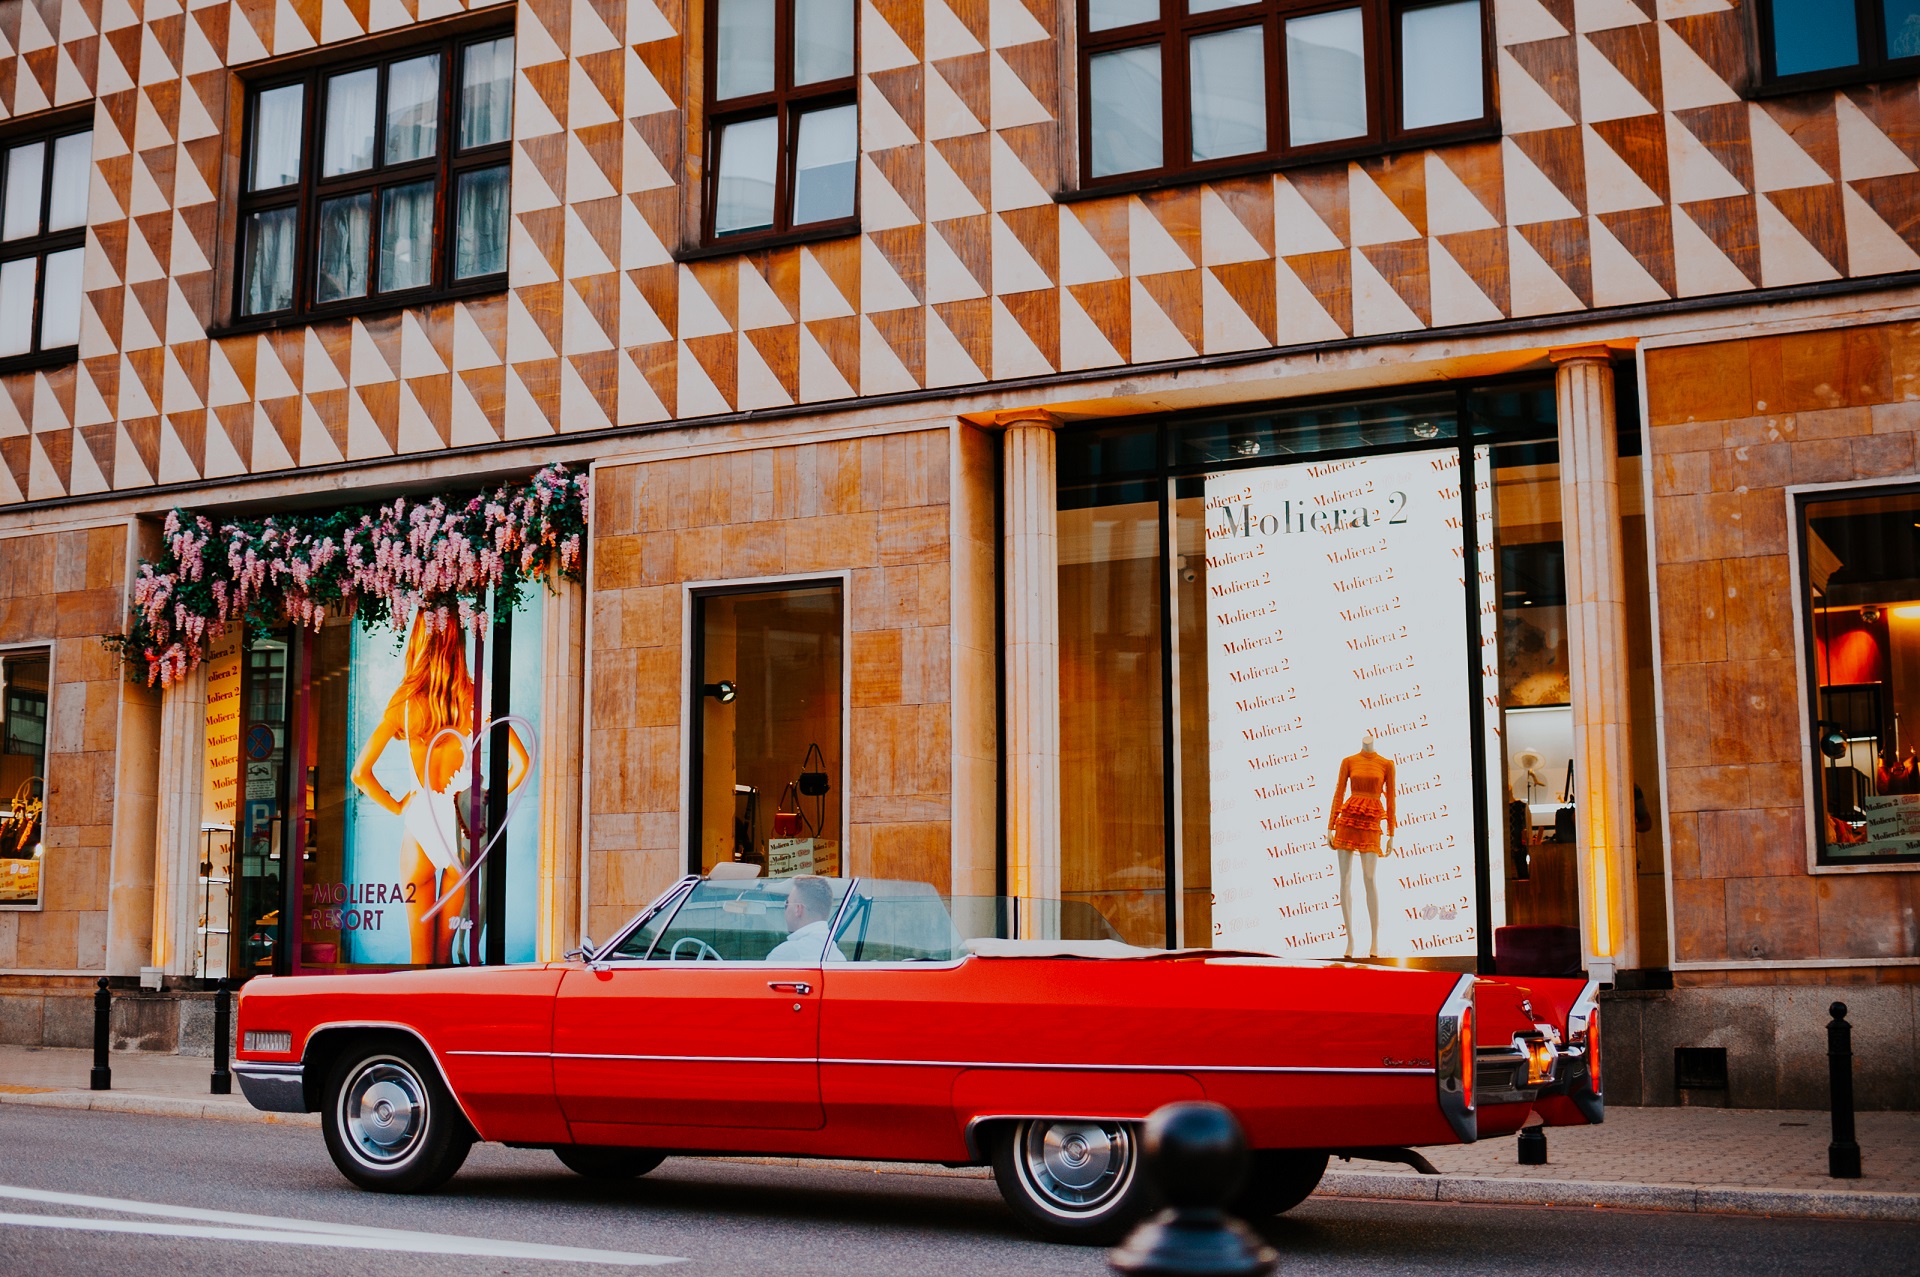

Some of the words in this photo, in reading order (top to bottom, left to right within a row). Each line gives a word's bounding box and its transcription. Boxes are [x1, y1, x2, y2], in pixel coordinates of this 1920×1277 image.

[1206, 493, 1241, 511] oliera
[1244, 487, 1252, 499] 2
[1314, 488, 1362, 508] Moliera
[1365, 480, 1374, 495] 2
[1219, 500, 1370, 540] Moliera
[1389, 491, 1408, 524] 2
[1250, 515, 1258, 527] 2
[1372, 509, 1381, 521] 2
[1205, 552, 1253, 571] Moliera
[1256, 544, 1264, 559] 2
[1327, 546, 1376, 565] Moliera
[1379, 538, 1388, 553] 2
[1211, 579, 1259, 598] Moliera
[1262, 572, 1270, 586] 2
[1333, 575, 1382, 594] Moliera
[1385, 568, 1394, 582] 2
[1217, 609, 1265, 629] Moliera
[1268, 600, 1276, 616] 2
[1340, 604, 1389, 623] Moliera
[1392, 596, 1400, 611] 2
[229, 645, 235, 654] 2
[1223, 638, 1272, 658] Moliera
[1275, 630, 1284, 645] 2
[1346, 633, 1396, 652] Moliera
[1399, 626, 1408, 640] 2
[208, 669, 231, 682] oliera
[232, 666, 238, 675] 2
[1229, 665, 1278, 684] Moliera
[1281, 658, 1290, 672] 2
[1353, 662, 1403, 682] Moliera
[1406, 654, 1414, 669] 2
[234, 687, 240, 696] 2
[1236, 695, 1285, 714] Moliera
[1288, 688, 1296, 702] 2
[1360, 692, 1410, 711] Moliera
[1413, 684, 1422, 699] 2
[206, 712, 235, 726] Moliera
[1242, 724, 1291, 742] Moliera
[1294, 716, 1302, 730] 2
[1420, 715, 1428, 727] 2
[208, 734, 238, 747] Moliera
[1248, 753, 1297, 771] Moliera
[1300, 746, 1308, 759] 2
[1394, 749, 1423, 766] liera
[1427, 745, 1435, 756] 2
[1254, 782, 1304, 801] Moliera
[1307, 774, 1316, 789] 2
[1434, 774, 1442, 787] 2
[1260, 814, 1310, 832] Moliera
[1313, 806, 1322, 820] 2
[1441, 804, 1448, 817] 2
[1267, 842, 1317, 861] Moliera
[1320, 834, 1328, 849] 2
[1393, 842, 1443, 860] Moliera
[1446, 834, 1454, 848] 2
[1273, 872, 1323, 890] Moliera
[1326, 864, 1334, 878] 2
[1398, 873, 1450, 891] Moliera
[1453, 866, 1462, 879] 2
[312, 883, 417, 904] MOLIERA2
[1460, 896, 1468, 909] 2
[311, 909, 384, 931] RESORT
[1279, 901, 1330, 920] Moliera
[1333, 894, 1342, 908] 2
[1214, 923, 1222, 935] 2
[1286, 932, 1336, 950] Moliera
[1338, 924, 1347, 938] 2
[1411, 934, 1463, 952] Moliera
[1465, 926, 1474, 940] 2
